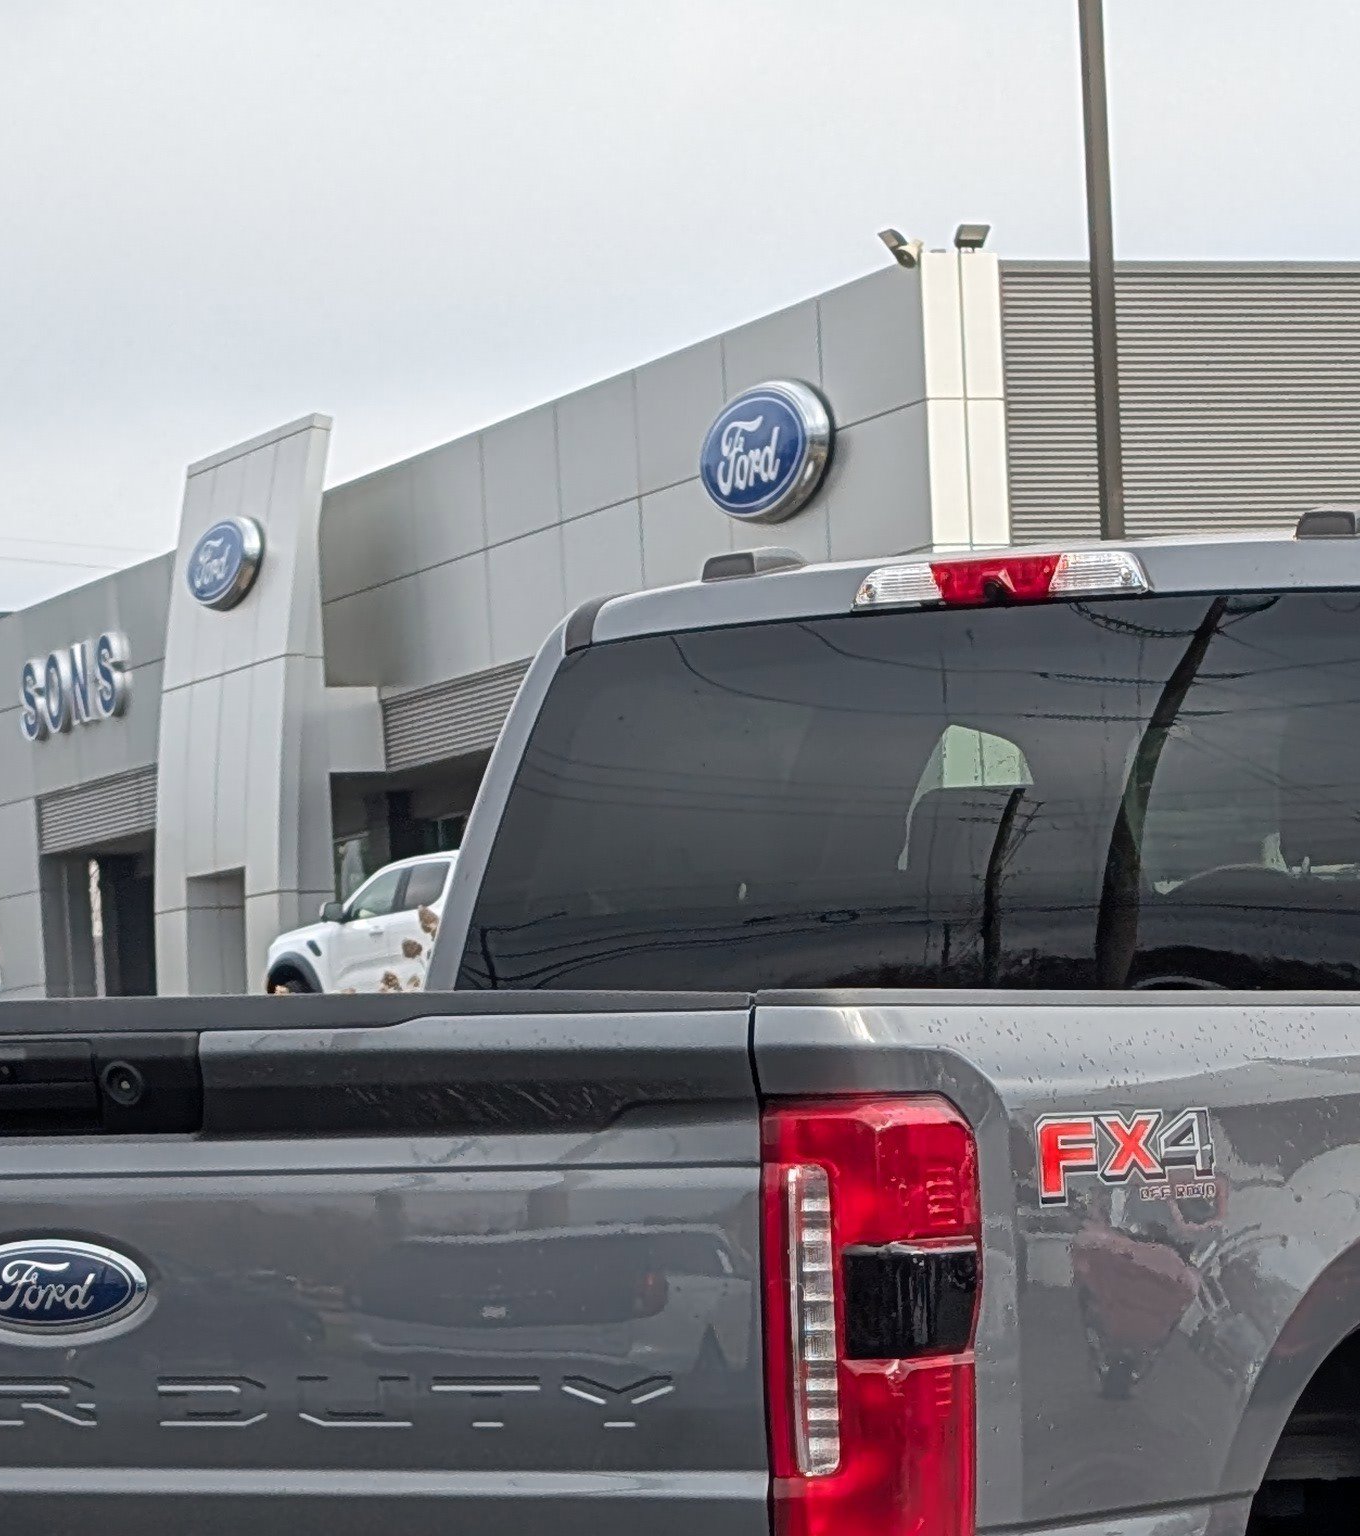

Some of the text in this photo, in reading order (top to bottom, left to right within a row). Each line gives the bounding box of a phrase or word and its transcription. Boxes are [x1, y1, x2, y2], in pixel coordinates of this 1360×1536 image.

[717, 415, 780, 496] Ford
[193, 537, 232, 589] Ford
[21, 633, 120, 740] SONS
[1034, 1107, 1216, 1209] FX4
[1140, 1182, 1216, 1201] OFF ROAD
[156, 1375, 675, 1428] DUTY
